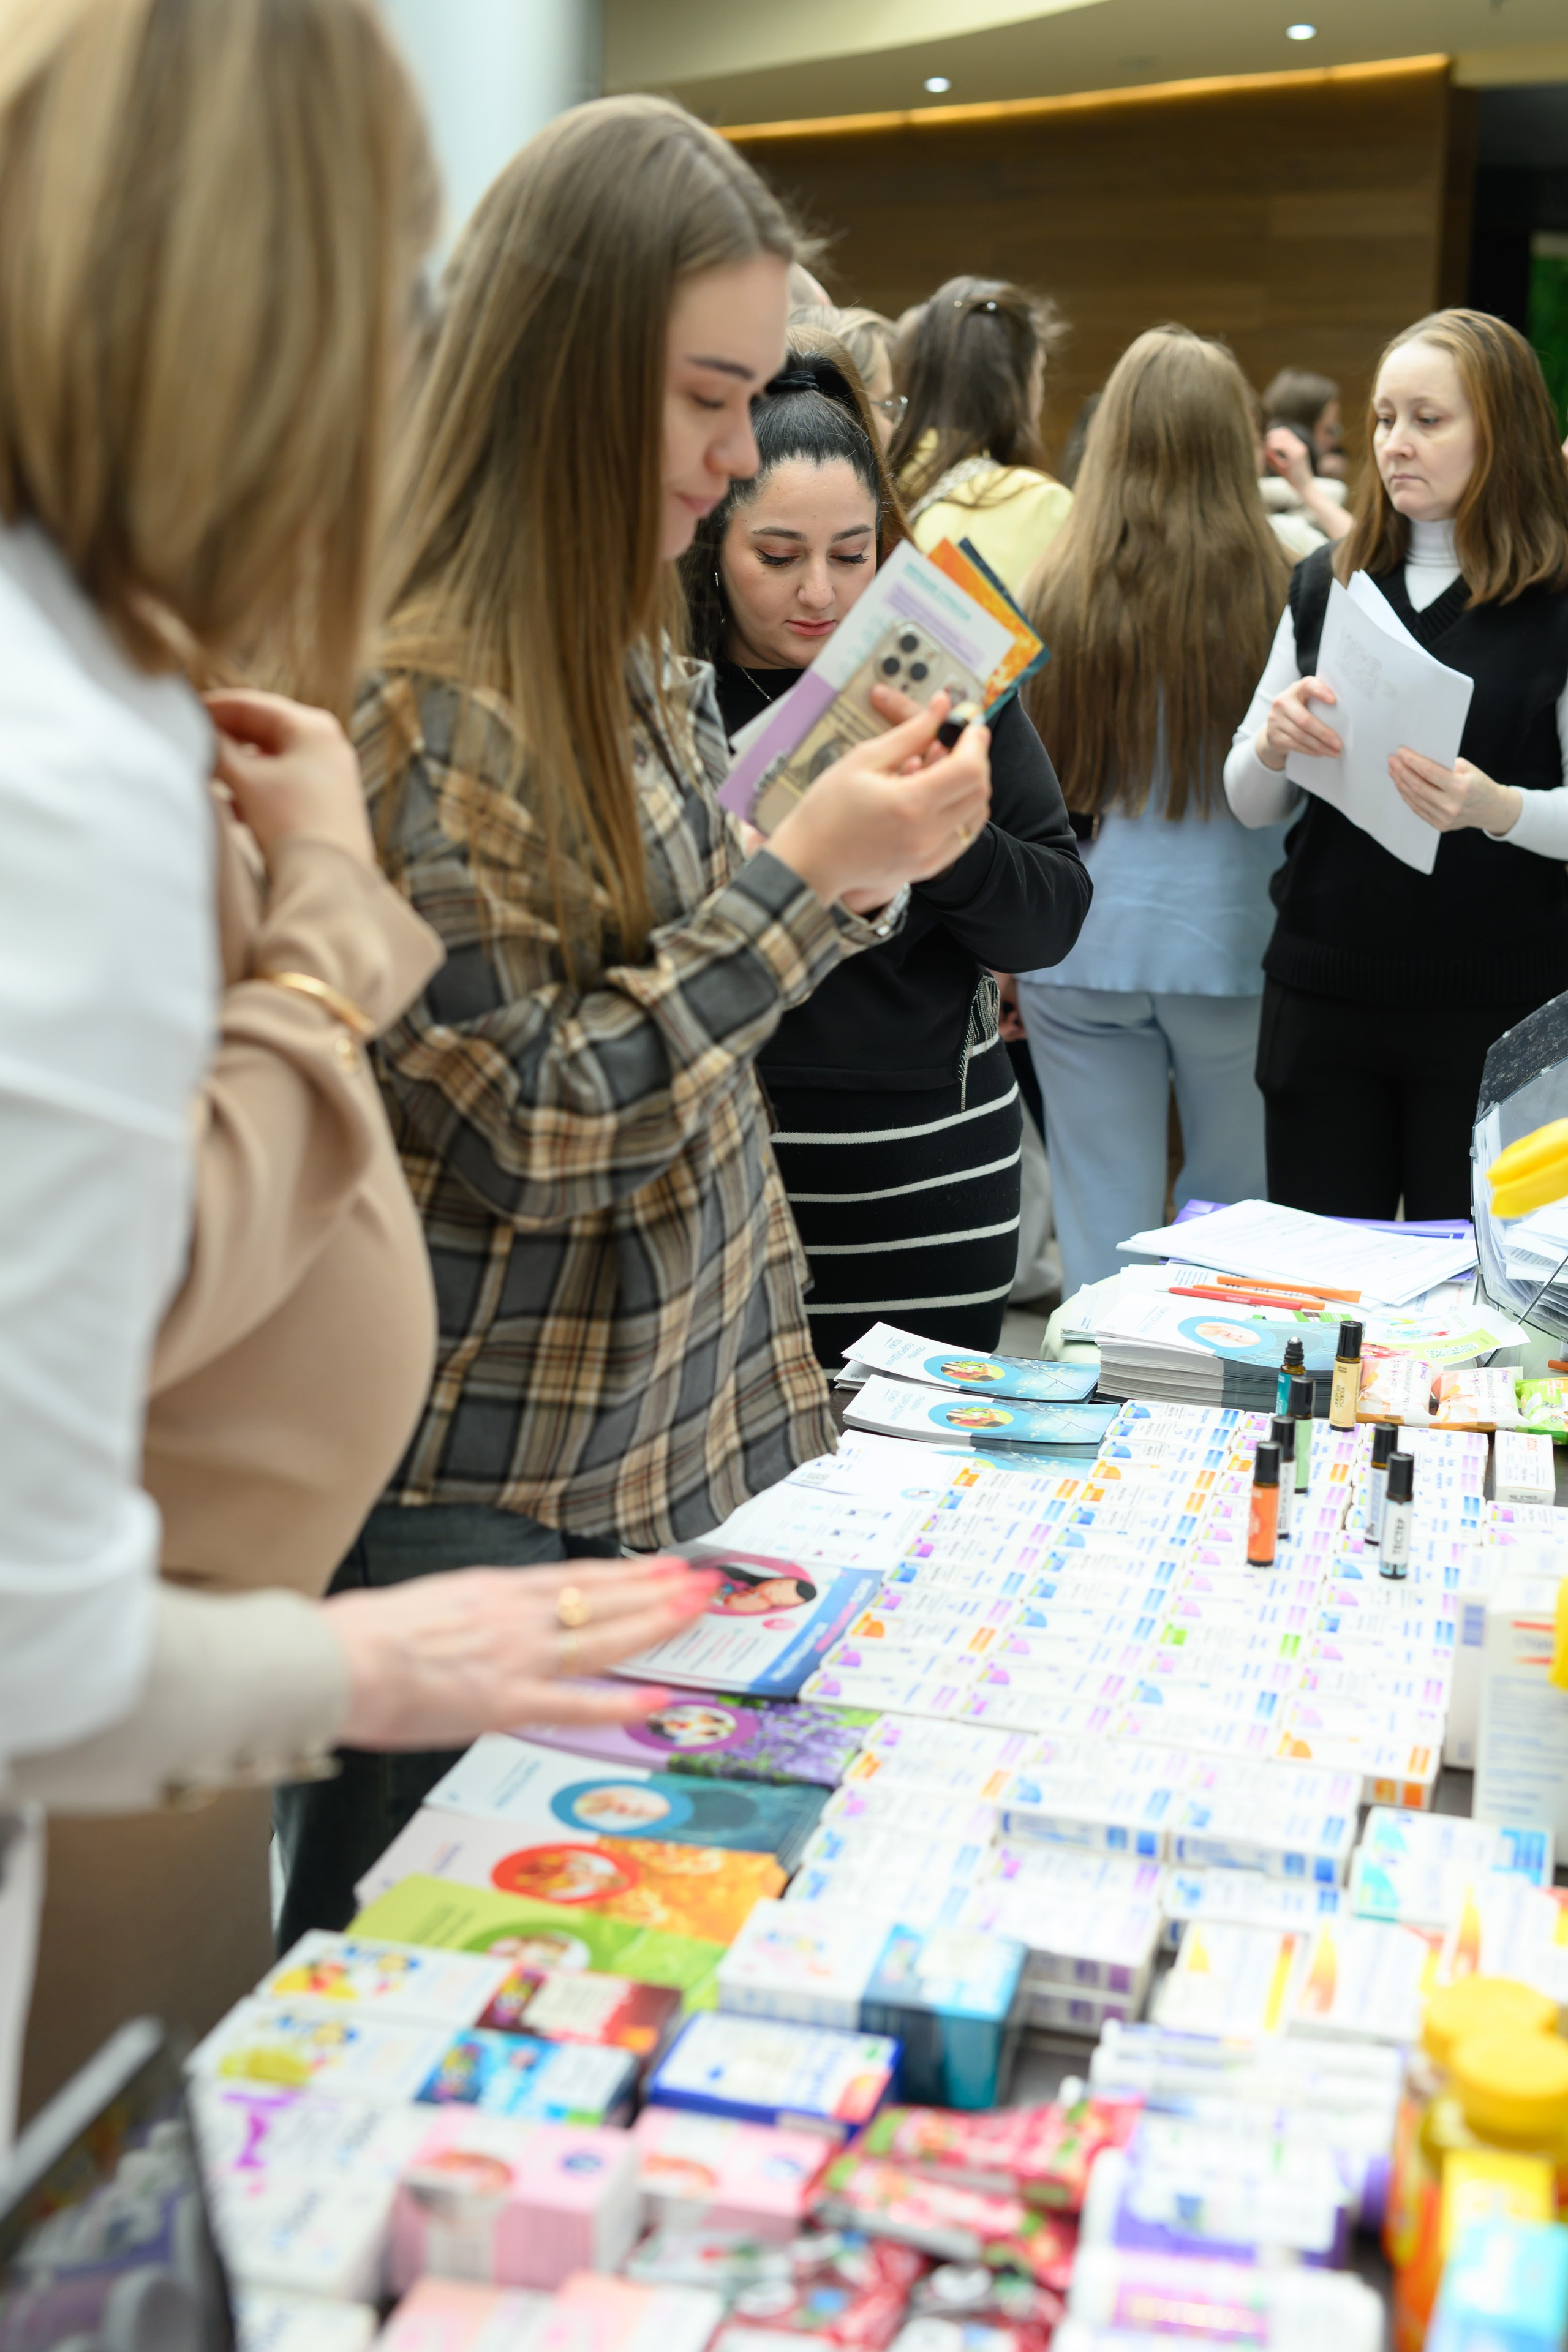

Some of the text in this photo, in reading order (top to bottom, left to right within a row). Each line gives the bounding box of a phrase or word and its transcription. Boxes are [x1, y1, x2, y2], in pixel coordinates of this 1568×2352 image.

[888, 1339, 902, 1350] КОЖИ
[907, 1346, 926, 1360] ТРАВМЫ
[888, 1391, 900, 1403] КОЖИ
[1392, 1517, 1404, 1555] ТЕСТЕР
